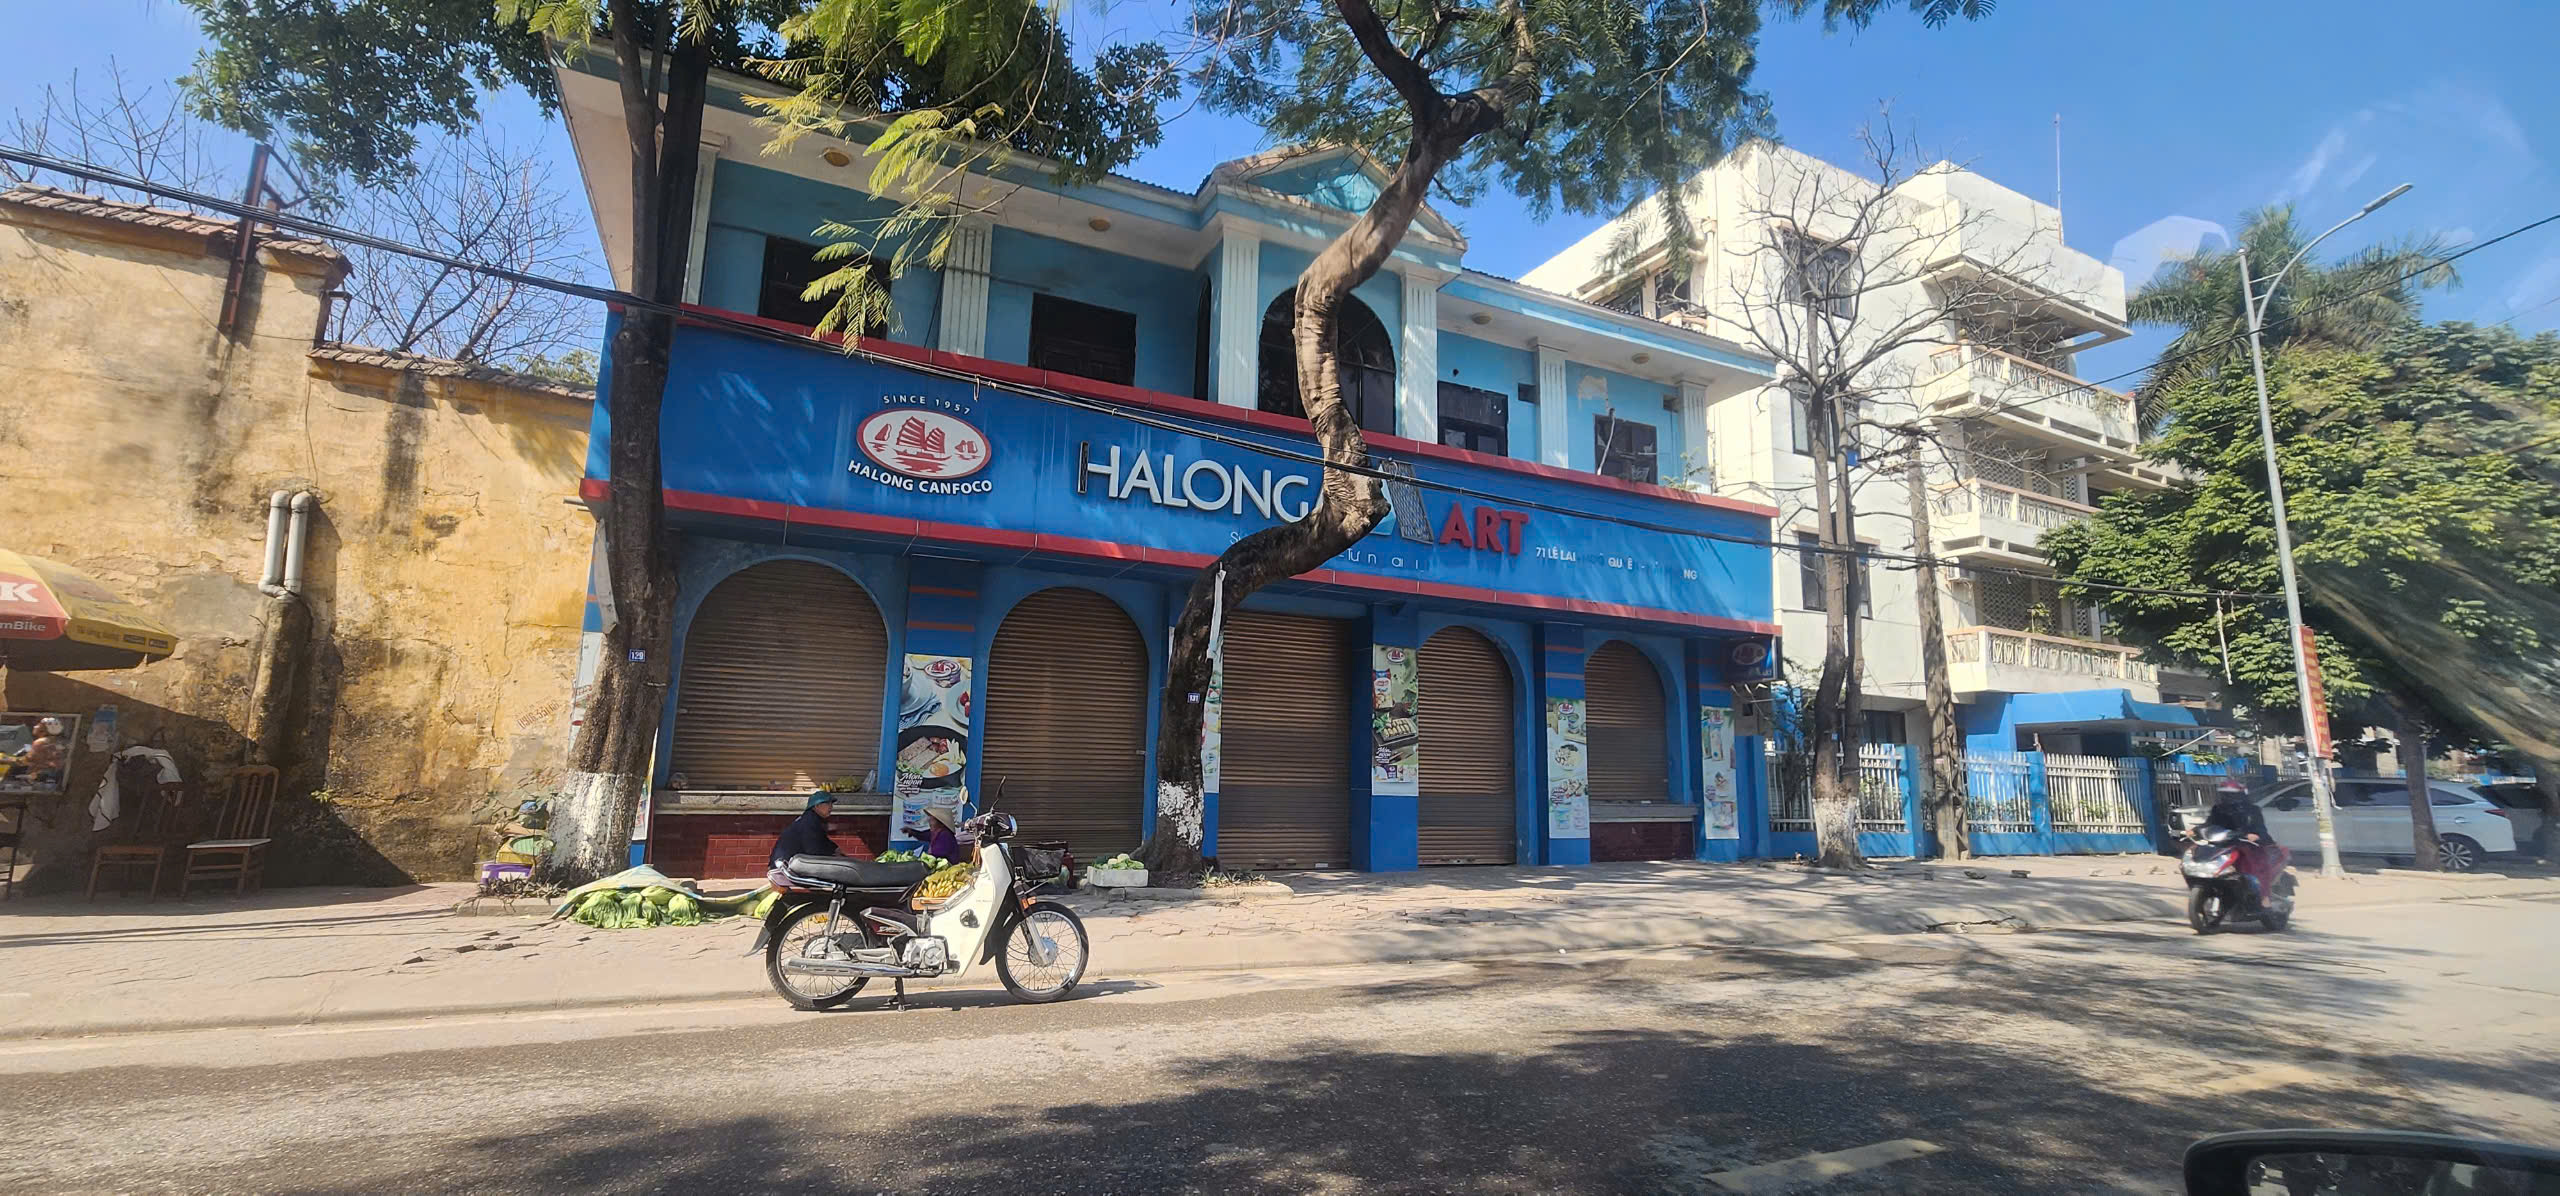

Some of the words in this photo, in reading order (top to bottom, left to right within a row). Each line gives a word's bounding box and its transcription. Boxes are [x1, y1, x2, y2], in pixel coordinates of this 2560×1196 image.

[883, 394, 926, 405] SINCE
[935, 398, 971, 415] 1957
[848, 460, 914, 491] HALONG
[918, 480, 993, 495] CANFOCO
[1077, 440, 1309, 524] HALONG
[1536, 546, 1546, 558] 71
[1560, 550, 1576, 562] LAI
